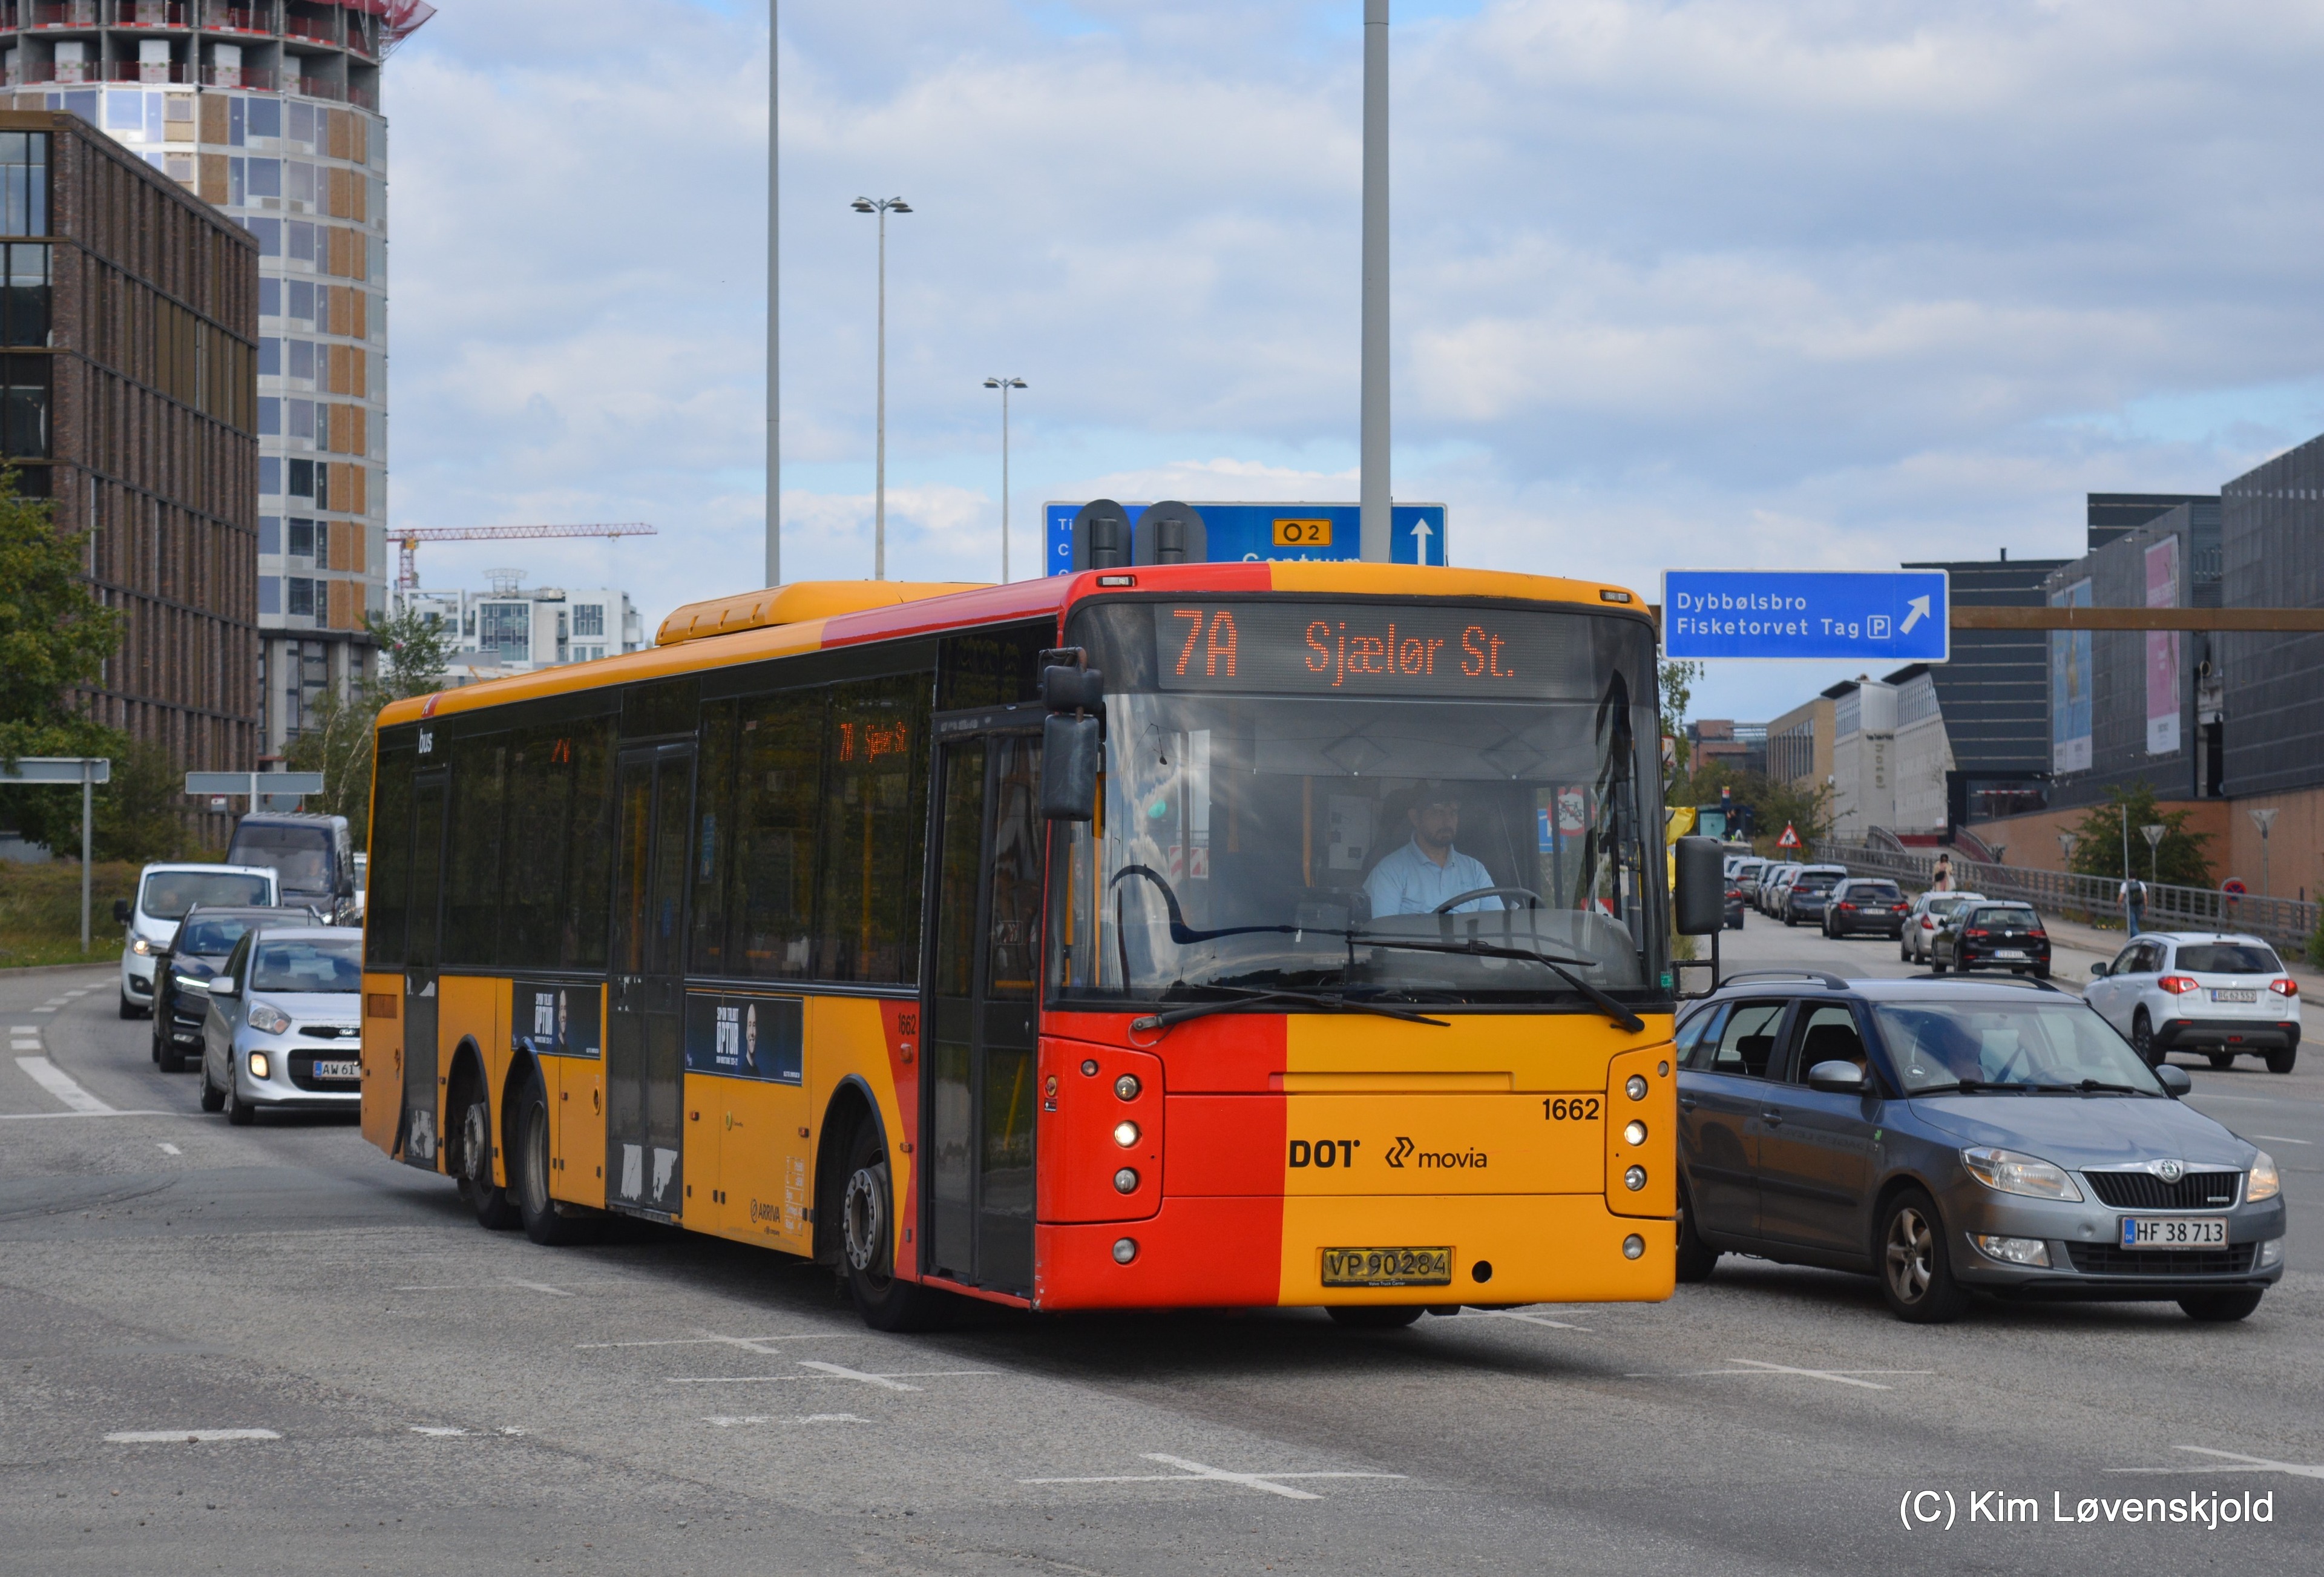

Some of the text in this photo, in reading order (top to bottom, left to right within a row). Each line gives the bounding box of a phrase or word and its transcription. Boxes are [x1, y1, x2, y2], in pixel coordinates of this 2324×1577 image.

[1308, 525, 1320, 541] 2
[1677, 593, 1807, 613] Dybbølsbro
[1677, 618, 1808, 635] Fisketorvet
[1821, 619, 1859, 639] Tag
[1173, 610, 1515, 687] 7A Sjælør St.
[419, 728, 433, 754] bus
[898, 1013, 916, 1035] 1662
[717, 1021, 739, 1055] OPTUR
[323, 1064, 338, 1075] AW
[1543, 1098, 1599, 1121] 1662
[1419, 1147, 1488, 1168] movia
[758, 1202, 780, 1223] ARRIVA
[2137, 1223, 2160, 1241] HF
[2166, 1223, 2187, 1242] 38
[2192, 1223, 2223, 1242] 713
[1330, 1254, 1446, 1276] VP 90 284
